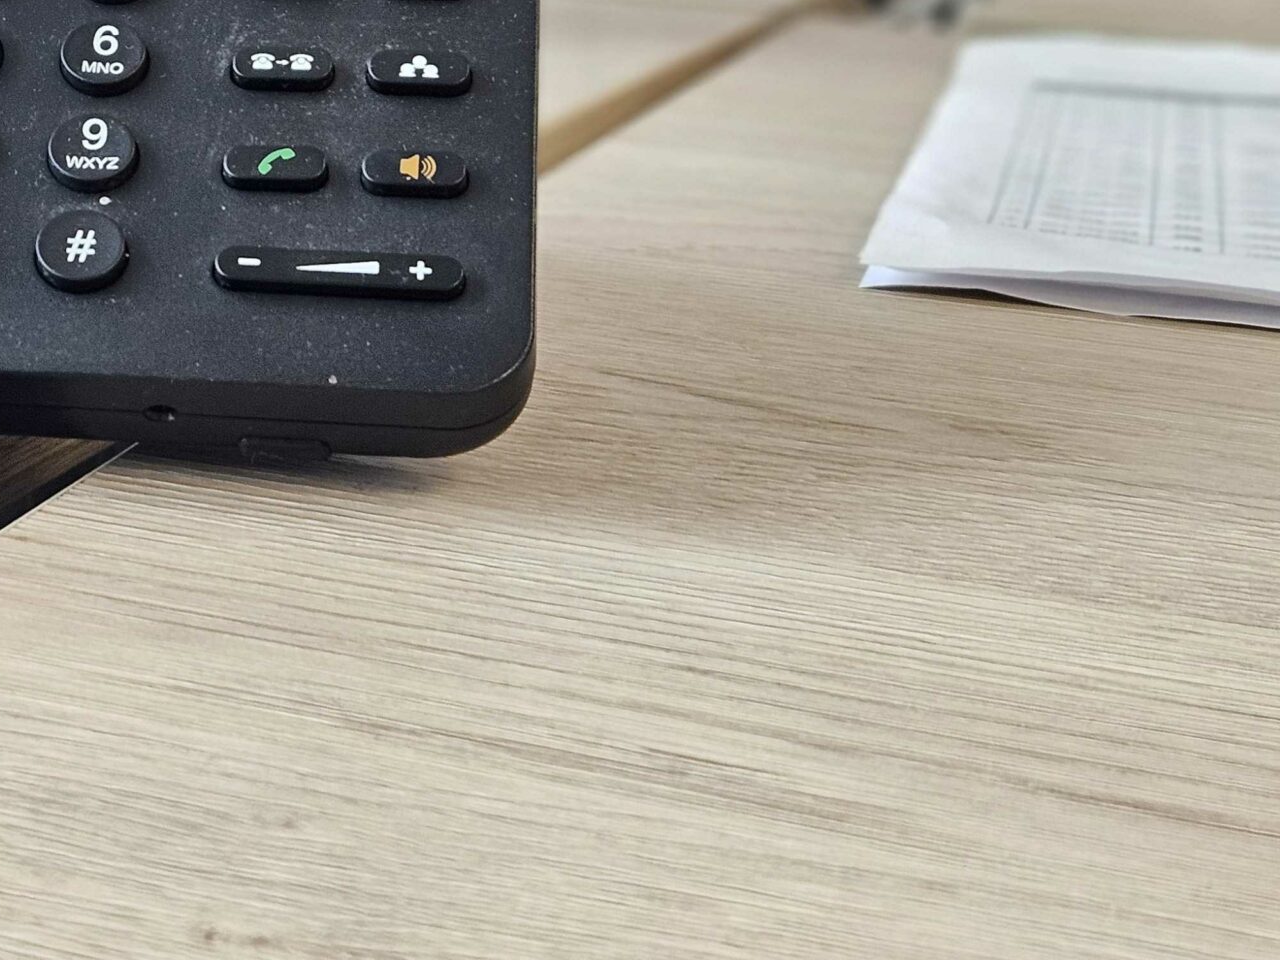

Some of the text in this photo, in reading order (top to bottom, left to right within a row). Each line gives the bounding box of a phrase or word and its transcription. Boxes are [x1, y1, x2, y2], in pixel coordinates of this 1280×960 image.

[92, 24, 120, 57] 6
[81, 60, 125, 75] MNO
[81, 117, 108, 151] 9
[65, 154, 120, 170] WXYZ
[65, 229, 97, 263] #
